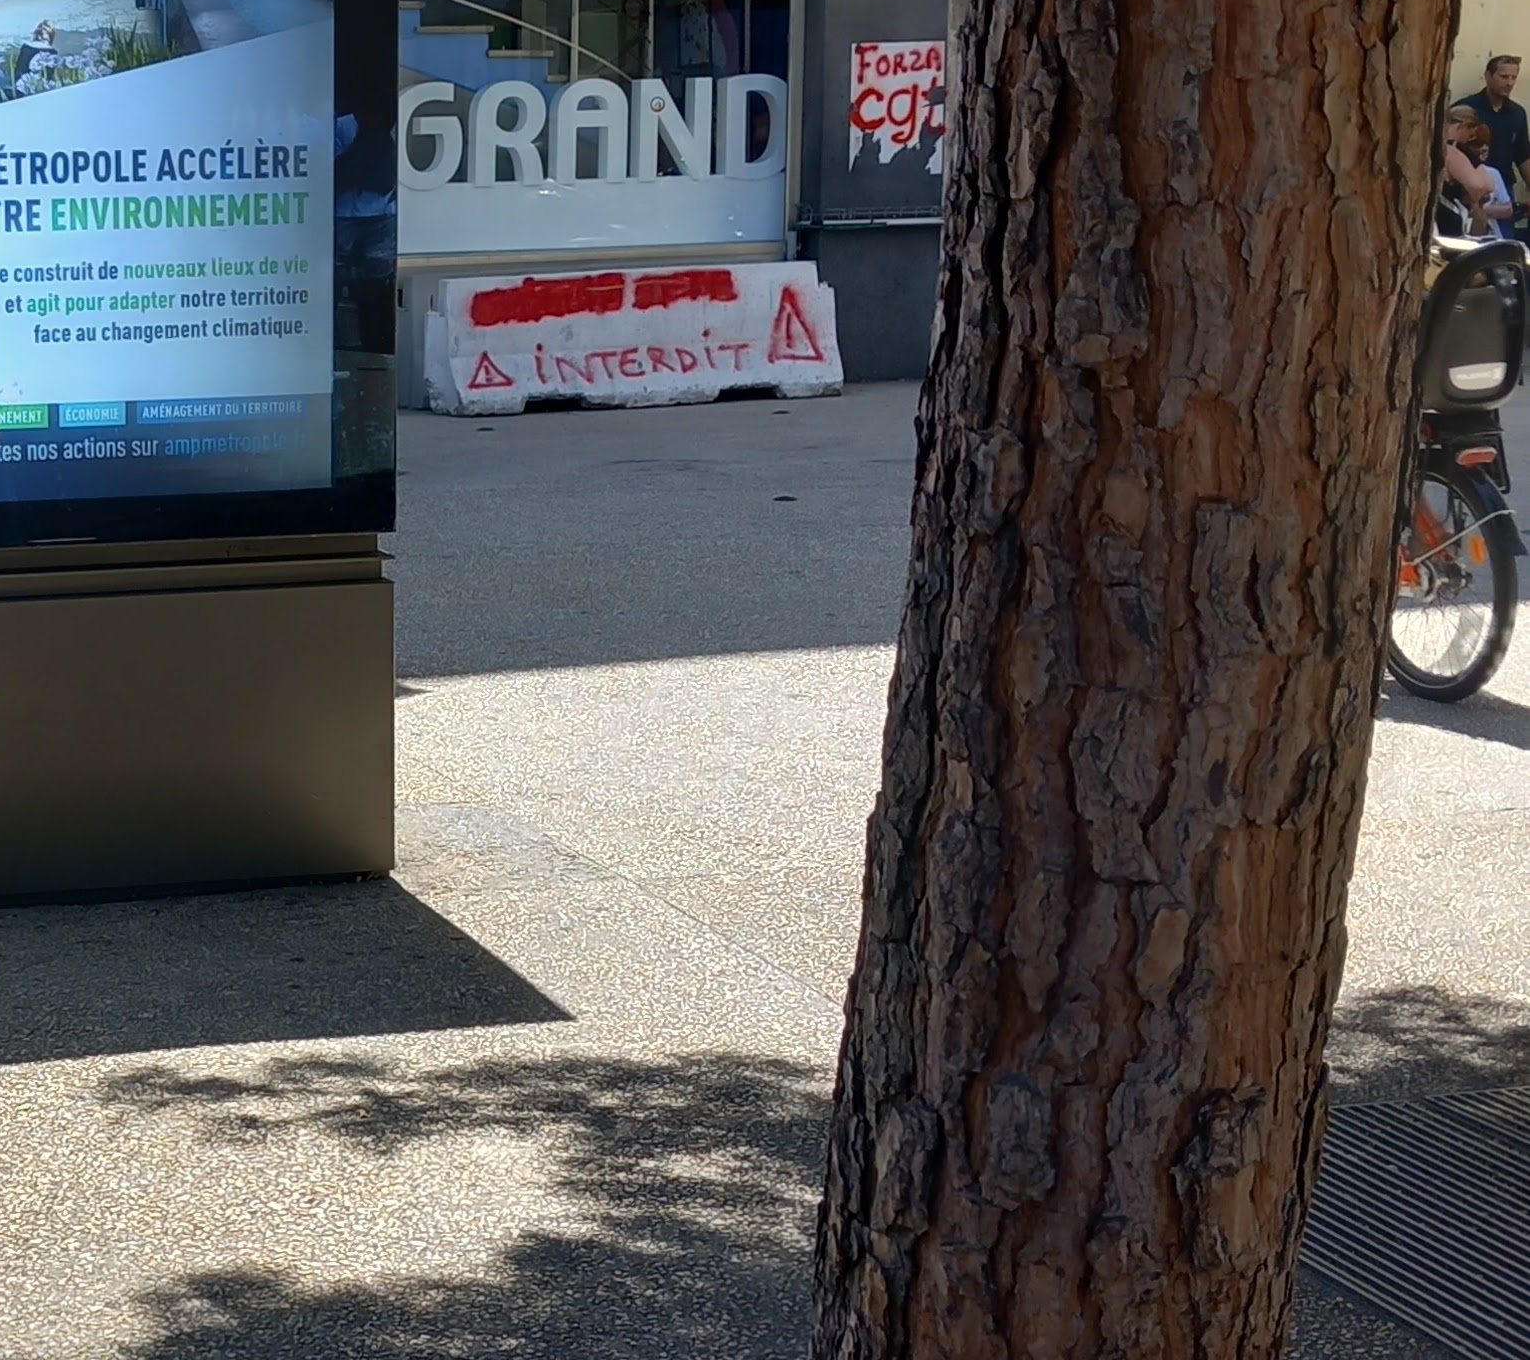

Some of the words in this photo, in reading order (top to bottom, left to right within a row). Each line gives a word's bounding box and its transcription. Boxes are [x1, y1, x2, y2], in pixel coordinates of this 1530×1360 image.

[398, 74, 788, 191] GRAND
[156, 137, 309, 183] ACCÉLÈRE
[51, 191, 310, 232] ENVIRONNEMENT
[13, 260, 94, 283] construit
[98, 261, 119, 280] de
[124, 262, 206, 280] nouveaux
[211, 258, 254, 278] lieux
[259, 256, 279, 276] de
[283, 256, 309, 275] vie
[5, 295, 22, 314] et
[27, 293, 61, 317] agit
[65, 297, 104, 317] pour
[108, 292, 176, 315] adapter
[180, 289, 226, 309] notre
[230, 286, 309, 307] territoire
[34, 324, 71, 343] face
[76, 326, 97, 342] au
[101, 320, 208, 344] changement
[212, 317, 309, 340] climatique.
[142, 403, 221, 419] AMÉNAGEMENT
[225, 403, 239, 416] DU
[242, 400, 303, 415] TERRITOIRE
[27, 443, 58, 461] nos
[63, 437, 126, 460] actions
[132, 439, 160, 457] sur
